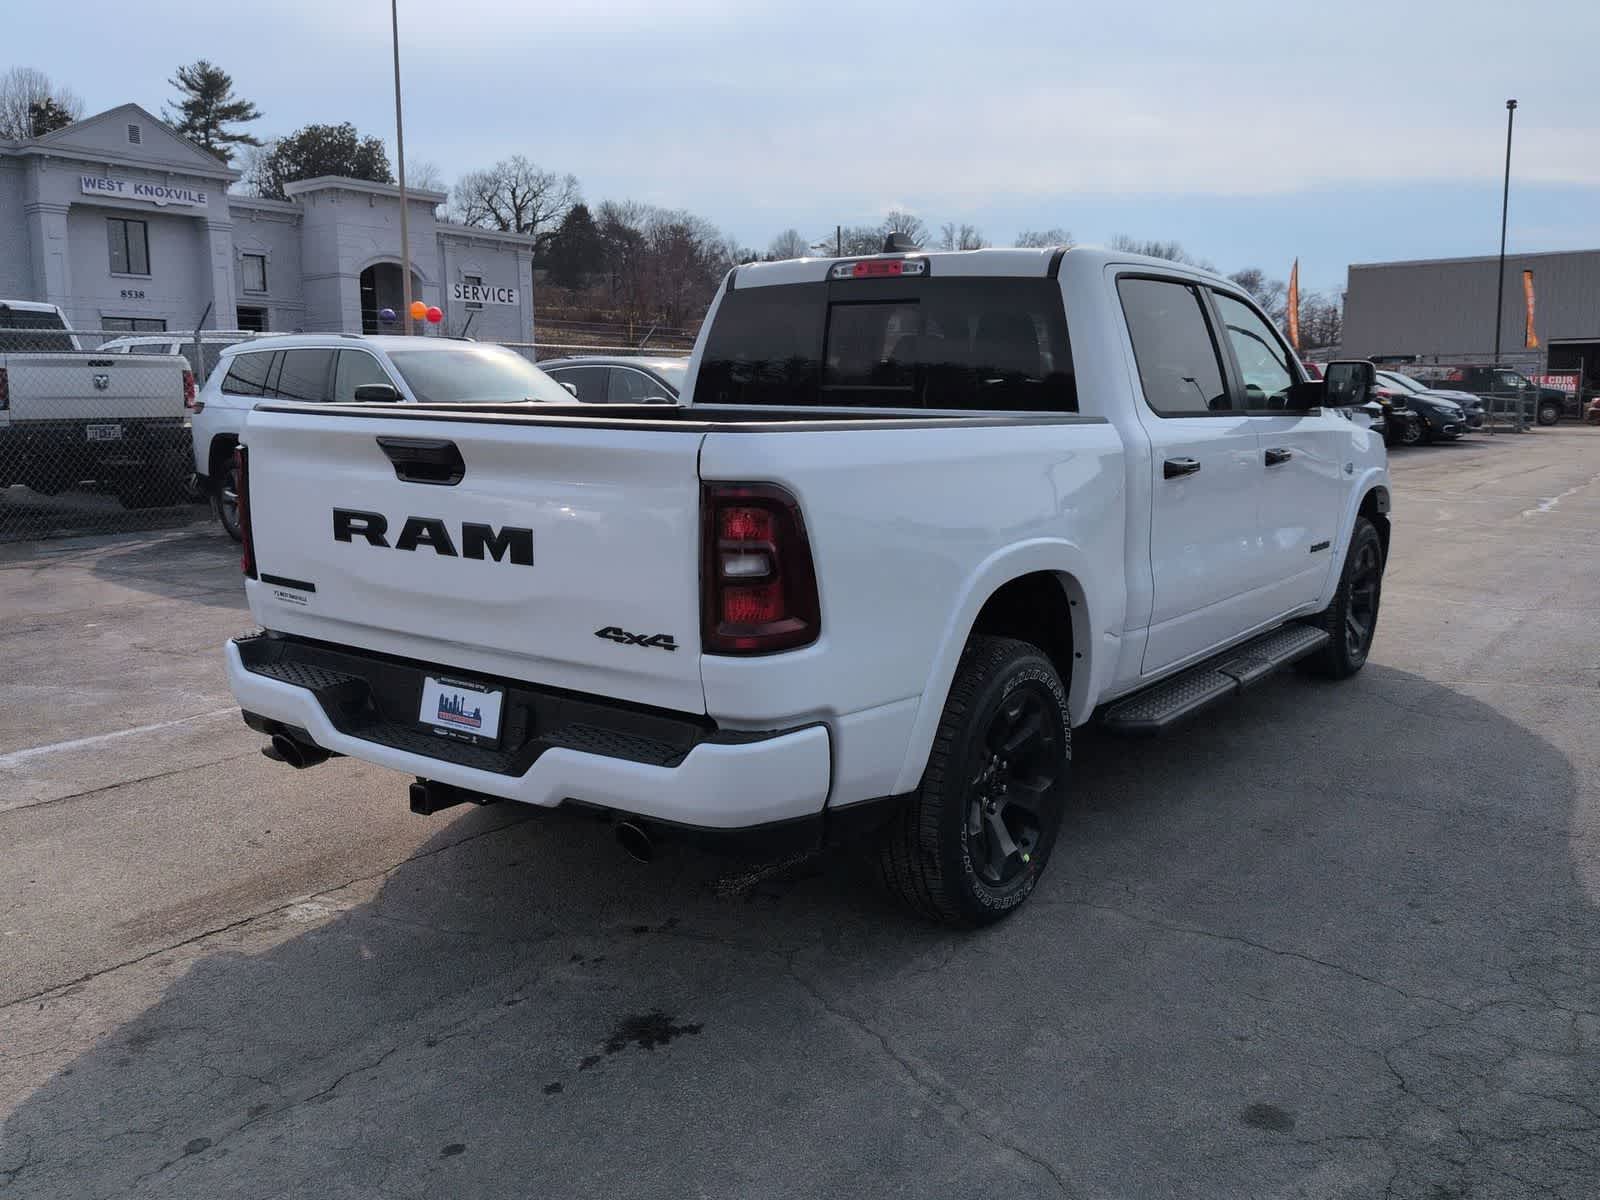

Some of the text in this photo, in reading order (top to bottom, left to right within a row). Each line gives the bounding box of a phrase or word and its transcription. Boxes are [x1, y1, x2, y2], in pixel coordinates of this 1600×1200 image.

[83, 176, 124, 192] WEST
[120, 289, 145, 299] 8538
[454, 284, 514, 303] SERVICE
[333, 507, 534, 566] RAM
